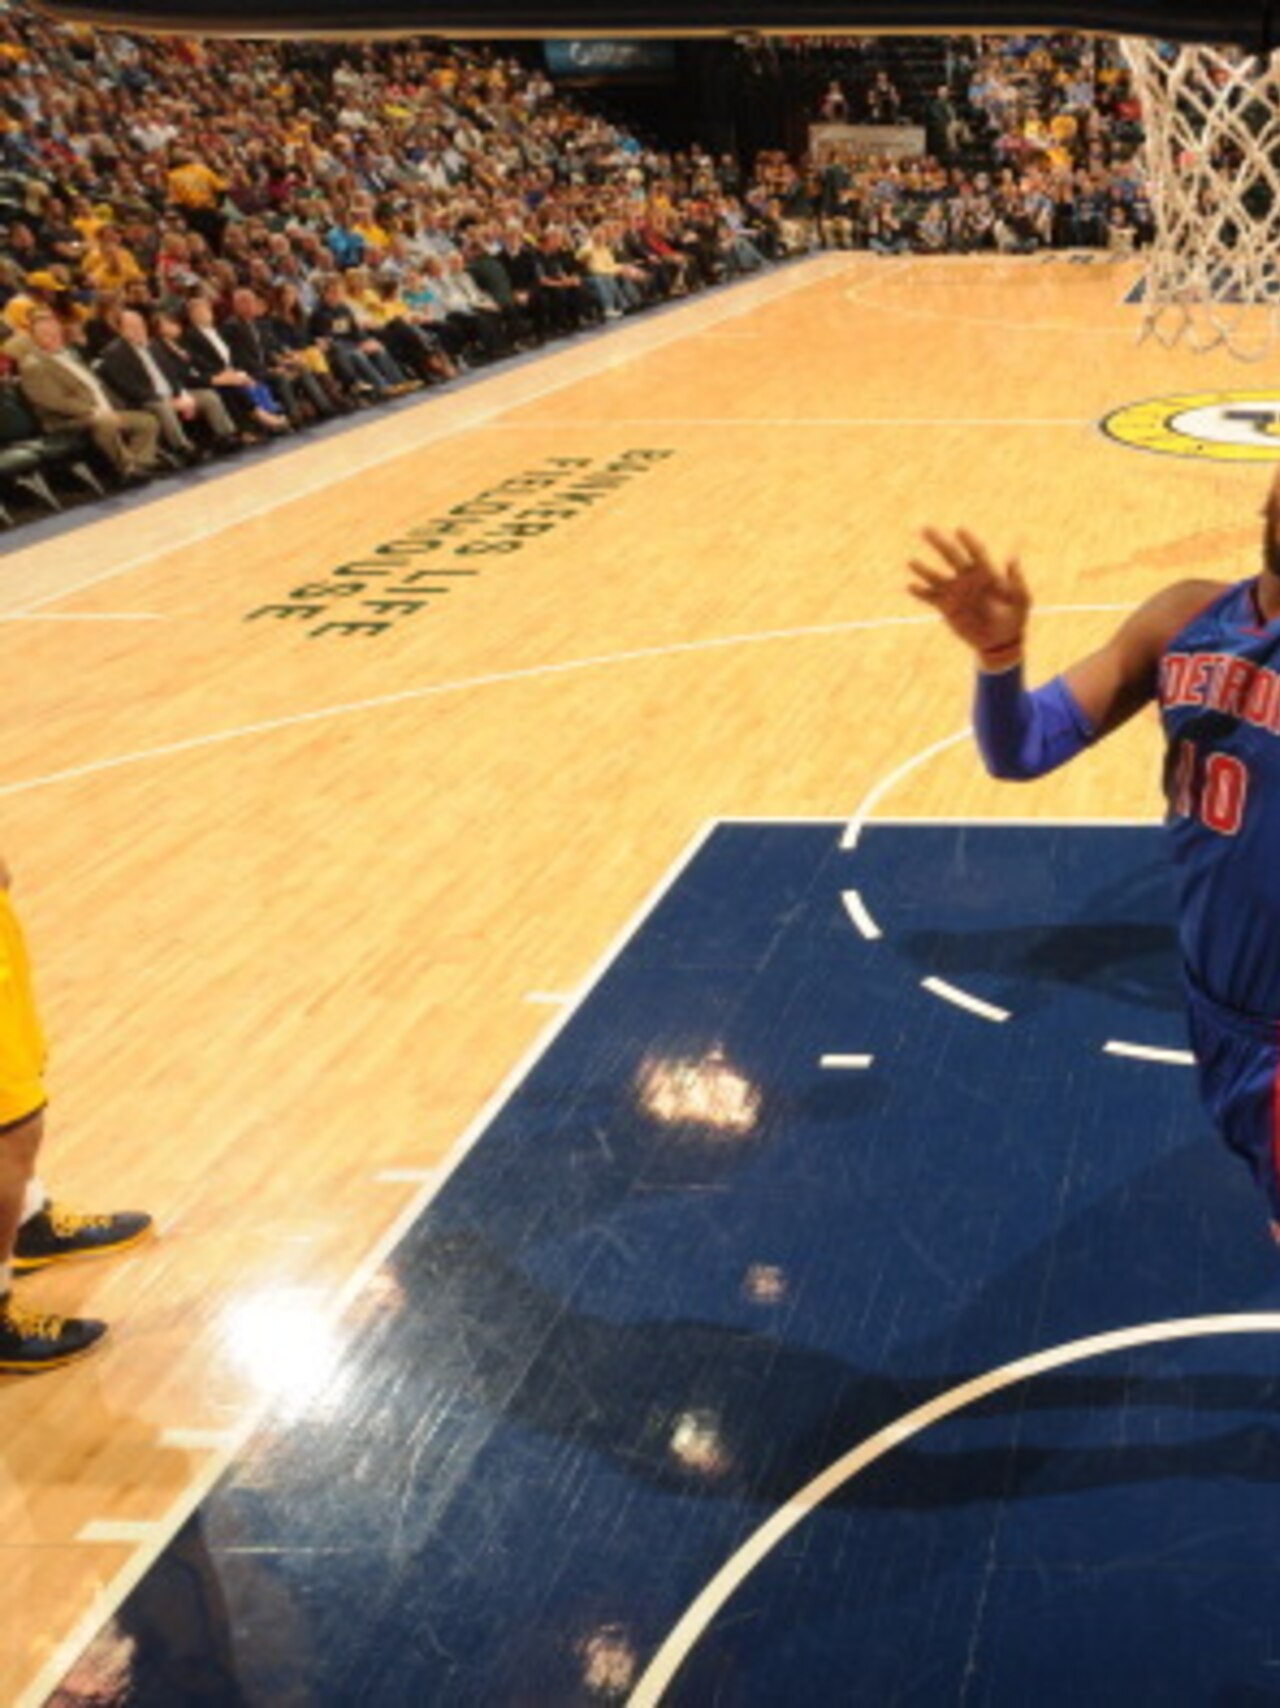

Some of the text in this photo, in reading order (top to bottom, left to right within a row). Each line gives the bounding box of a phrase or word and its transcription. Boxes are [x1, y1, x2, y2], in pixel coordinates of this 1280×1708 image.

[243, 457, 593, 622] FIELDHOUSE
[308, 449, 675, 638] BANKERS LIFE
[1175, 740, 1248, 836] 10
